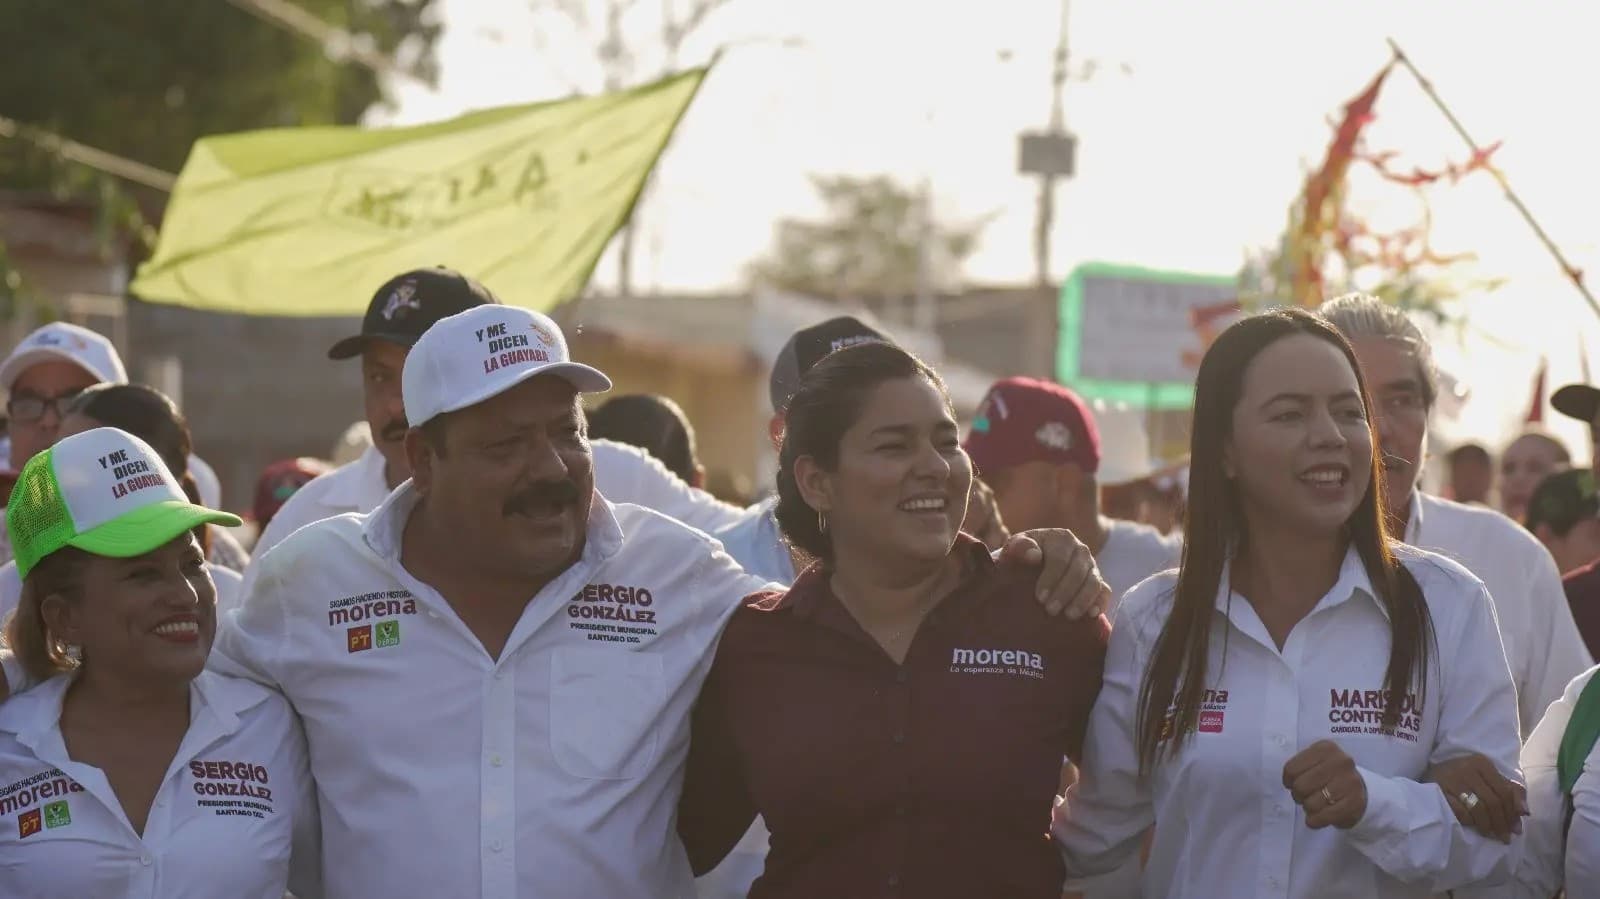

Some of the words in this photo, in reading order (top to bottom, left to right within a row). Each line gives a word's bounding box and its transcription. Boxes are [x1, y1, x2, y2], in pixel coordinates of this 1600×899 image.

[475, 329, 484, 342] Y
[487, 323, 507, 338] ME
[489, 335, 528, 353] DICEN
[483, 357, 499, 374] LA
[98, 456, 107, 469] Y
[109, 449, 129, 465] ME
[114, 460, 149, 480] DICEN
[112, 482, 128, 499] LA
[329, 596, 356, 609] SIGAMOS
[355, 591, 386, 603] HACIENDO
[328, 599, 417, 626] morena
[567, 604, 657, 624] GONZÁLEZ
[570, 622, 616, 633] PRESIDENTE
[351, 634, 370, 649] PT
[952, 647, 1044, 671] morena
[950, 666, 960, 674] La
[963, 666, 1004, 675] esperanza
[1007, 666, 1017, 675] de
[1330, 726, 1362, 734] CANDIDATA
[189, 760, 268, 785] SERGIO
[0, 778, 85, 816] morena
[193, 780, 273, 803] GONZÁLEZ
[197, 799, 243, 808] PRESIDENTE
[22, 816, 39, 834] PT
